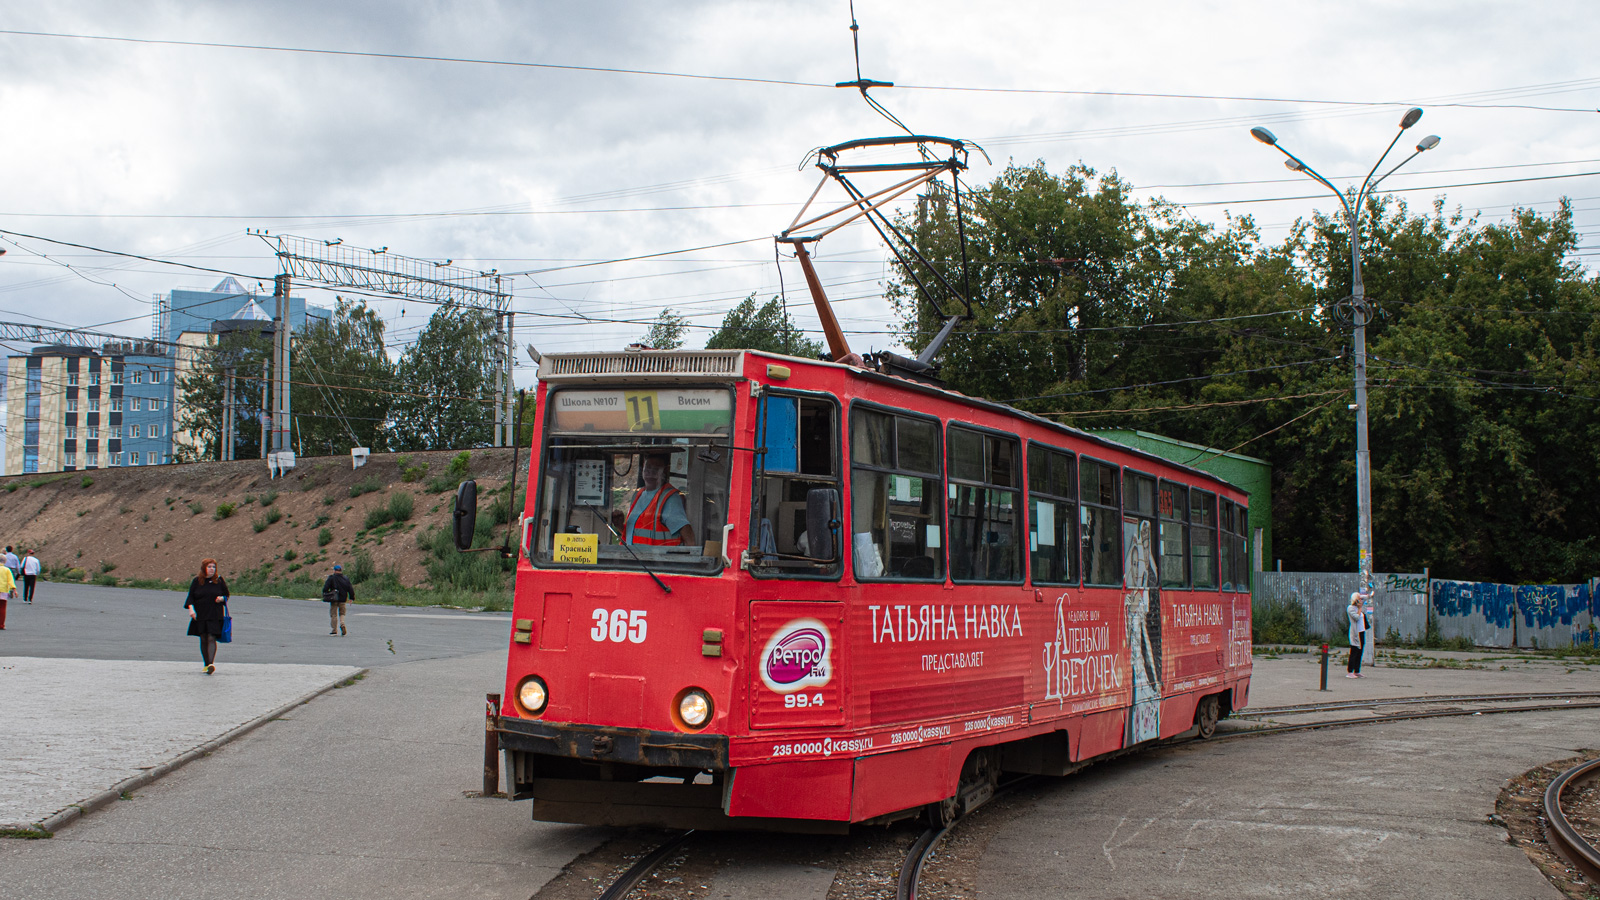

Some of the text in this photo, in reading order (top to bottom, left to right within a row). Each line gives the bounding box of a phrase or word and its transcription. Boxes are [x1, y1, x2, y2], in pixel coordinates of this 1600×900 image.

[562, 397, 618, 407] Школа №107
[678, 396, 711, 406] Висим
[627, 395, 655, 426] 11
[560, 544, 592, 553] Красный
[560, 554, 591, 564] Октябрь
[1172, 604, 1203, 628] ТАТЬЯНА
[591, 608, 648, 644] 365
[868, 604, 1023, 643] ТАТЬЯНА НАВКА
[773, 645, 822, 669] Ретро
[921, 651, 984, 673] ПРЕДСТАВЛЯЕТ
[784, 693, 825, 708] 99.4
[964, 721, 974, 732] 235
[974, 718, 987, 730] 0000
[891, 733, 903, 744] 235
[903, 731, 918, 742] 0000
[773, 745, 792, 757] 235
[794, 743, 822, 754] 0000
